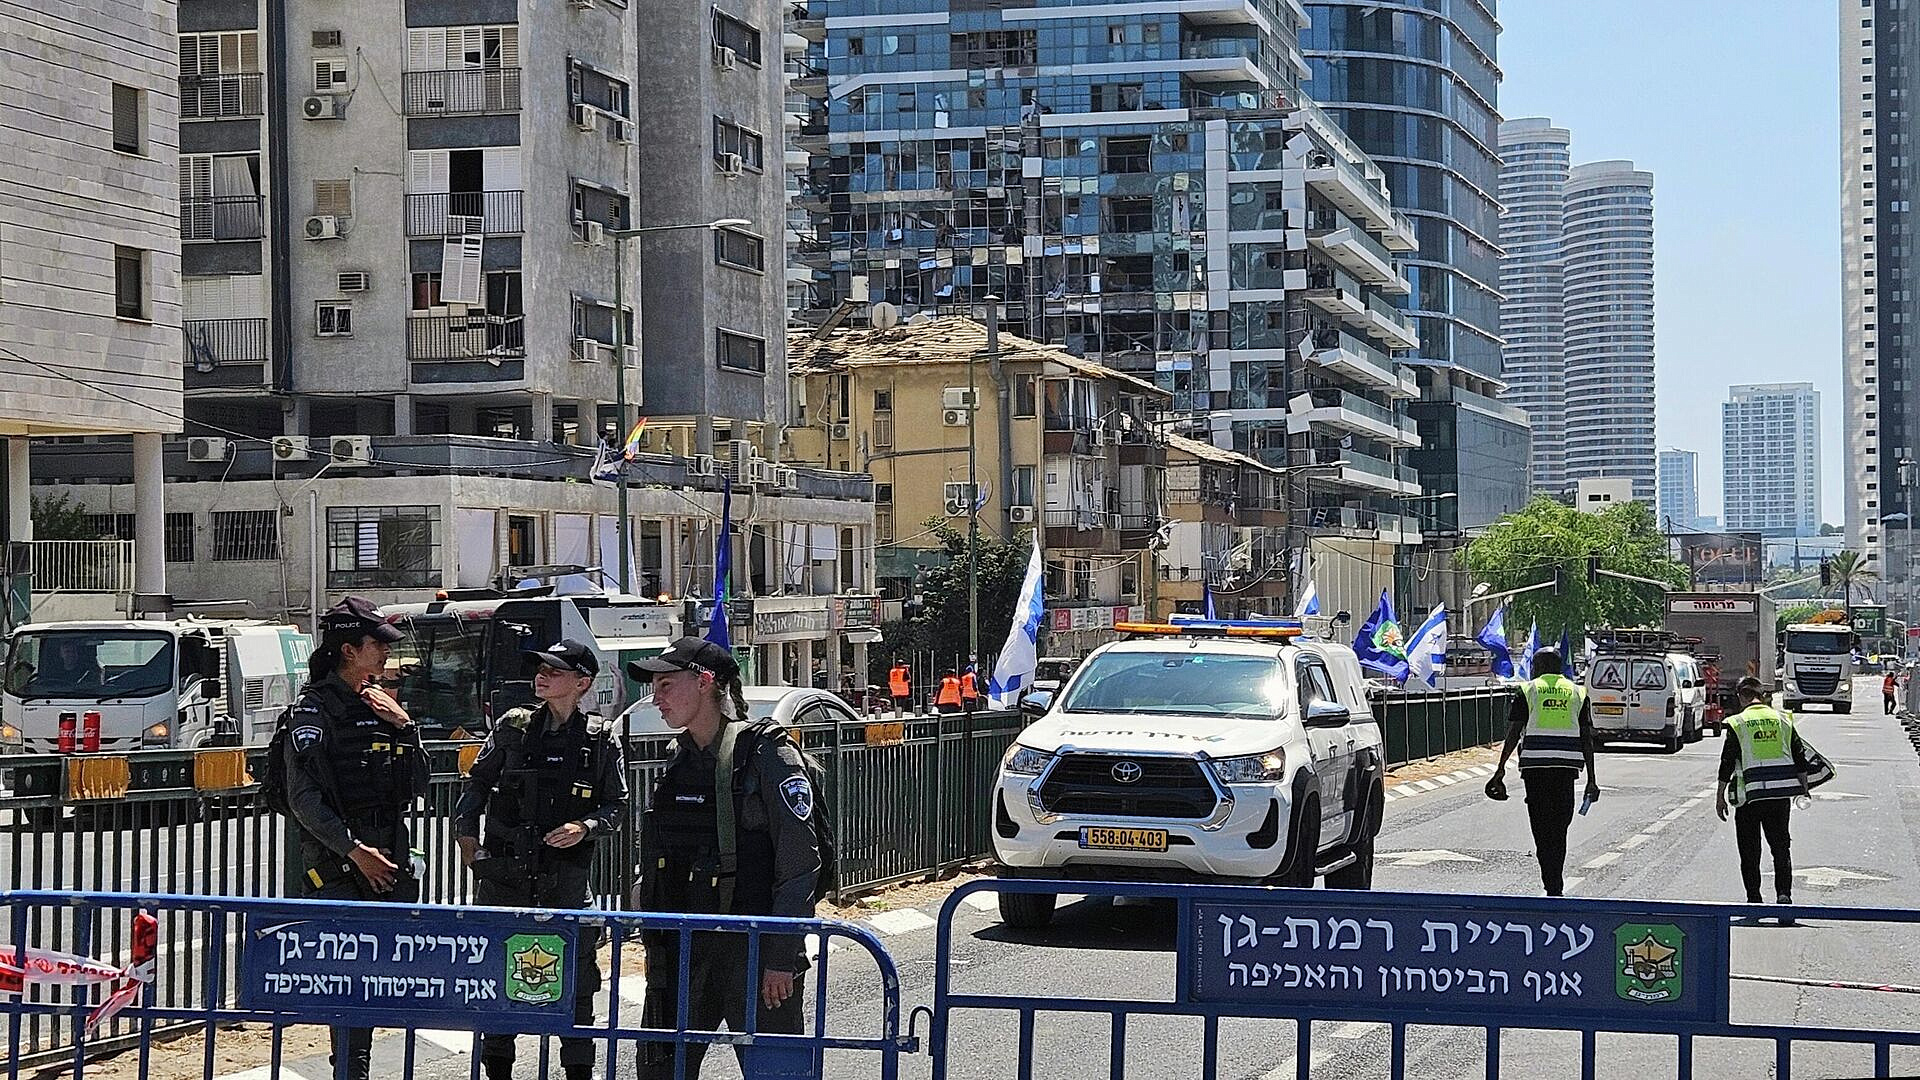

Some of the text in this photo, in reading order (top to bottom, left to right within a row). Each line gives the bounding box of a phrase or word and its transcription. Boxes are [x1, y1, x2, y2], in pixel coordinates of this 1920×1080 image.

[1693, 601, 1736, 609] מריומה
[1629, 693, 1640, 701] 11
[276, 931, 488, 965] עיריית רמת-גן
[1218, 913, 1394, 957] רמת-גן
[1421, 919, 1594, 960] עיריית
[264, 972, 497, 1004] אגף הביטחון והאכיפה
[1228, 962, 1582, 1002] אגף הביטחון והאכיפה
